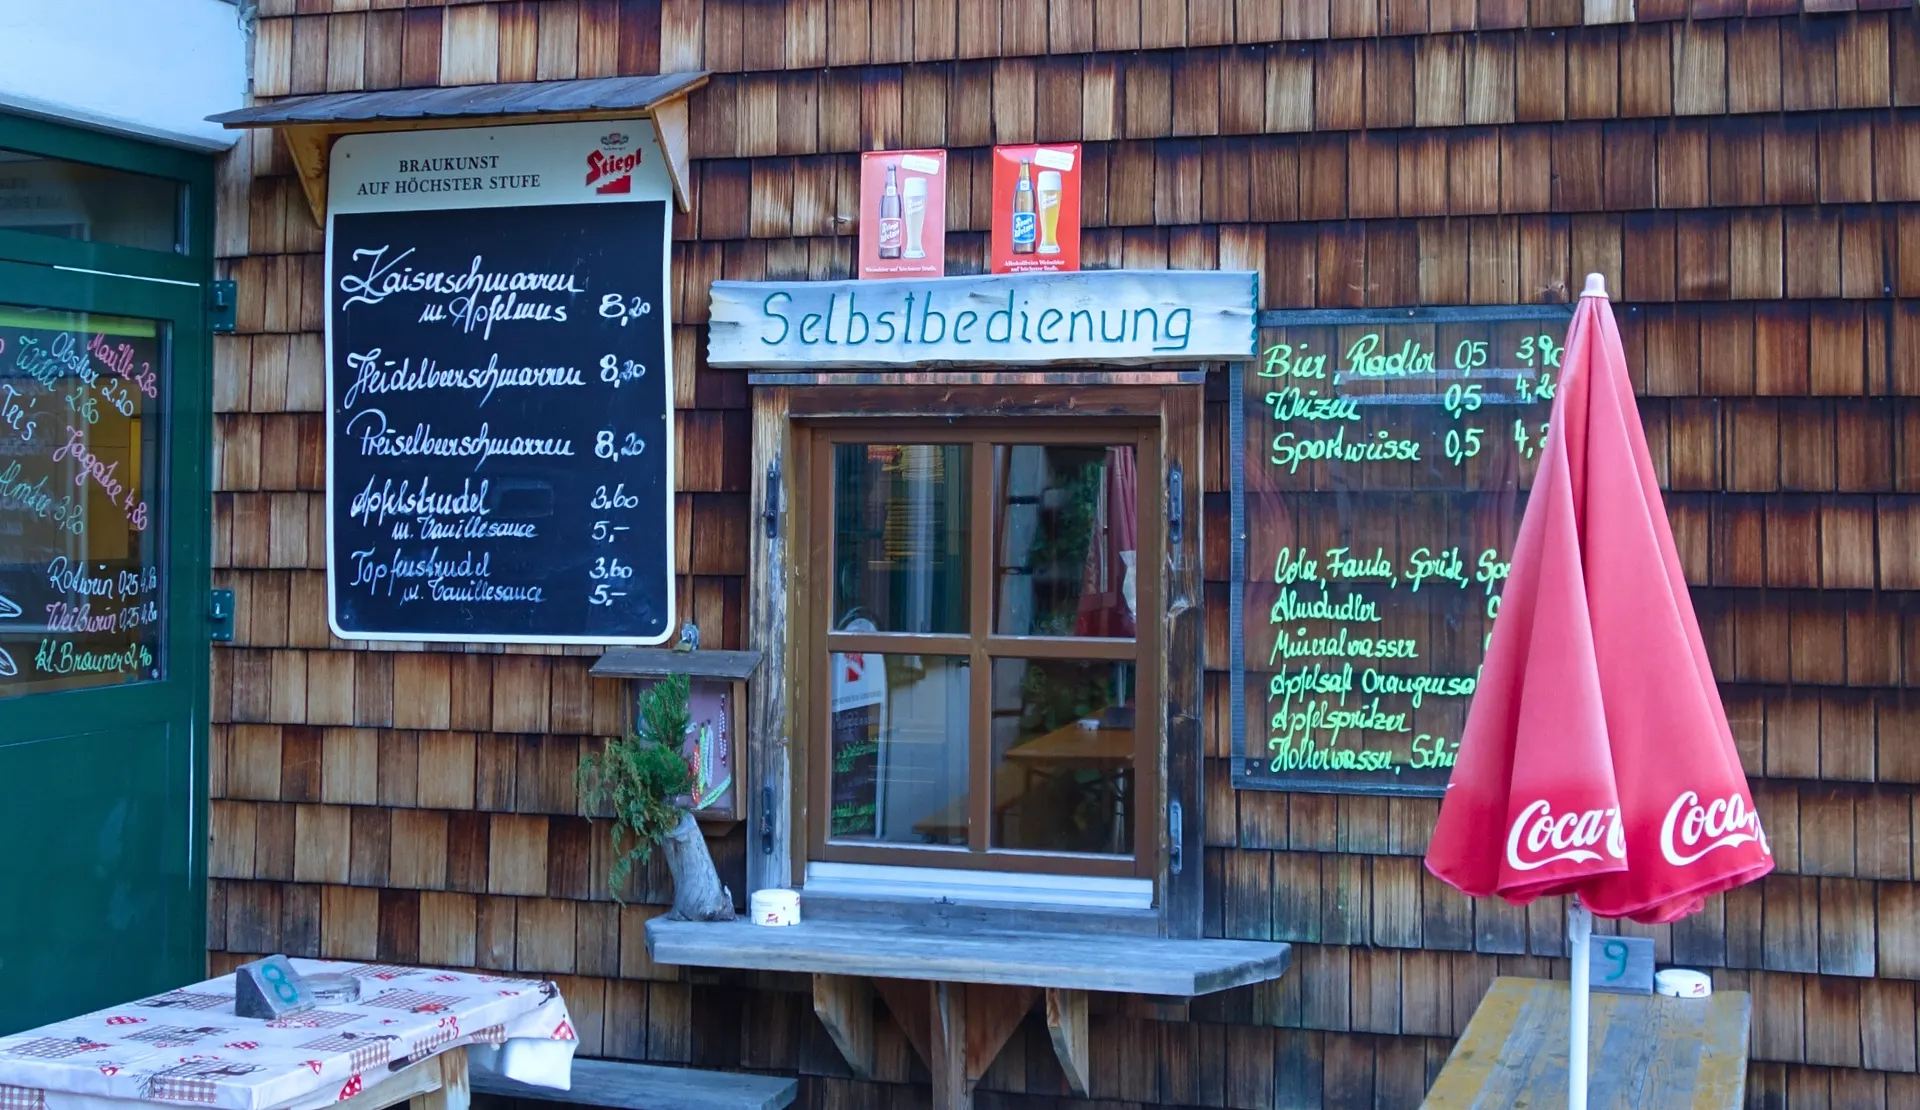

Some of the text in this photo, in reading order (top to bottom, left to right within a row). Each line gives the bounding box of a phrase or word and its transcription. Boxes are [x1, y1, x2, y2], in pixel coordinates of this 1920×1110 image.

[399, 155, 500, 173] BRAUKUNST
[586, 148, 642, 187] Stiegl
[357, 174, 541, 196] AUF HÖCHSTER STUFE
[340, 244, 585, 310] Kaiserschmarren
[449, 292, 568, 341] Apfelmus
[598, 293, 651, 327] 8,20
[760, 289, 1193, 350] Selbstbedienung
[51, 332, 99, 389] Obstler
[344, 348, 586, 409] Heidelbeerschmarren
[1257, 343, 1341, 386] Bier,
[1346, 333, 1436, 378] Radler
[1265, 386, 1361, 421] Weizen
[1444, 383, 1482, 420] 0,5
[346, 408, 646, 472] Preiselbeerschmarren 8,20
[1445, 428, 1484, 466] 0,5
[350, 474, 490, 527] Apfelstrudel
[416, 514, 539, 541] Vanillesauce
[47, 556, 114, 600] Rotwein
[350, 545, 633, 597] Topfenstrudel 3,60
[428, 576, 548, 603] Vanillesauce
[1274, 547, 1326, 590] Cola,
[1326, 547, 1397, 589] Fanta,
[1404, 547, 1469, 593] Sprite,
[1270, 586, 1382, 625] Almdudler
[53, 641, 124, 673] Brauner
[1270, 627, 1419, 666] Mineralwasser
[1603, 940, 1629, 981] 9
[261, 963, 298, 1004] 8
